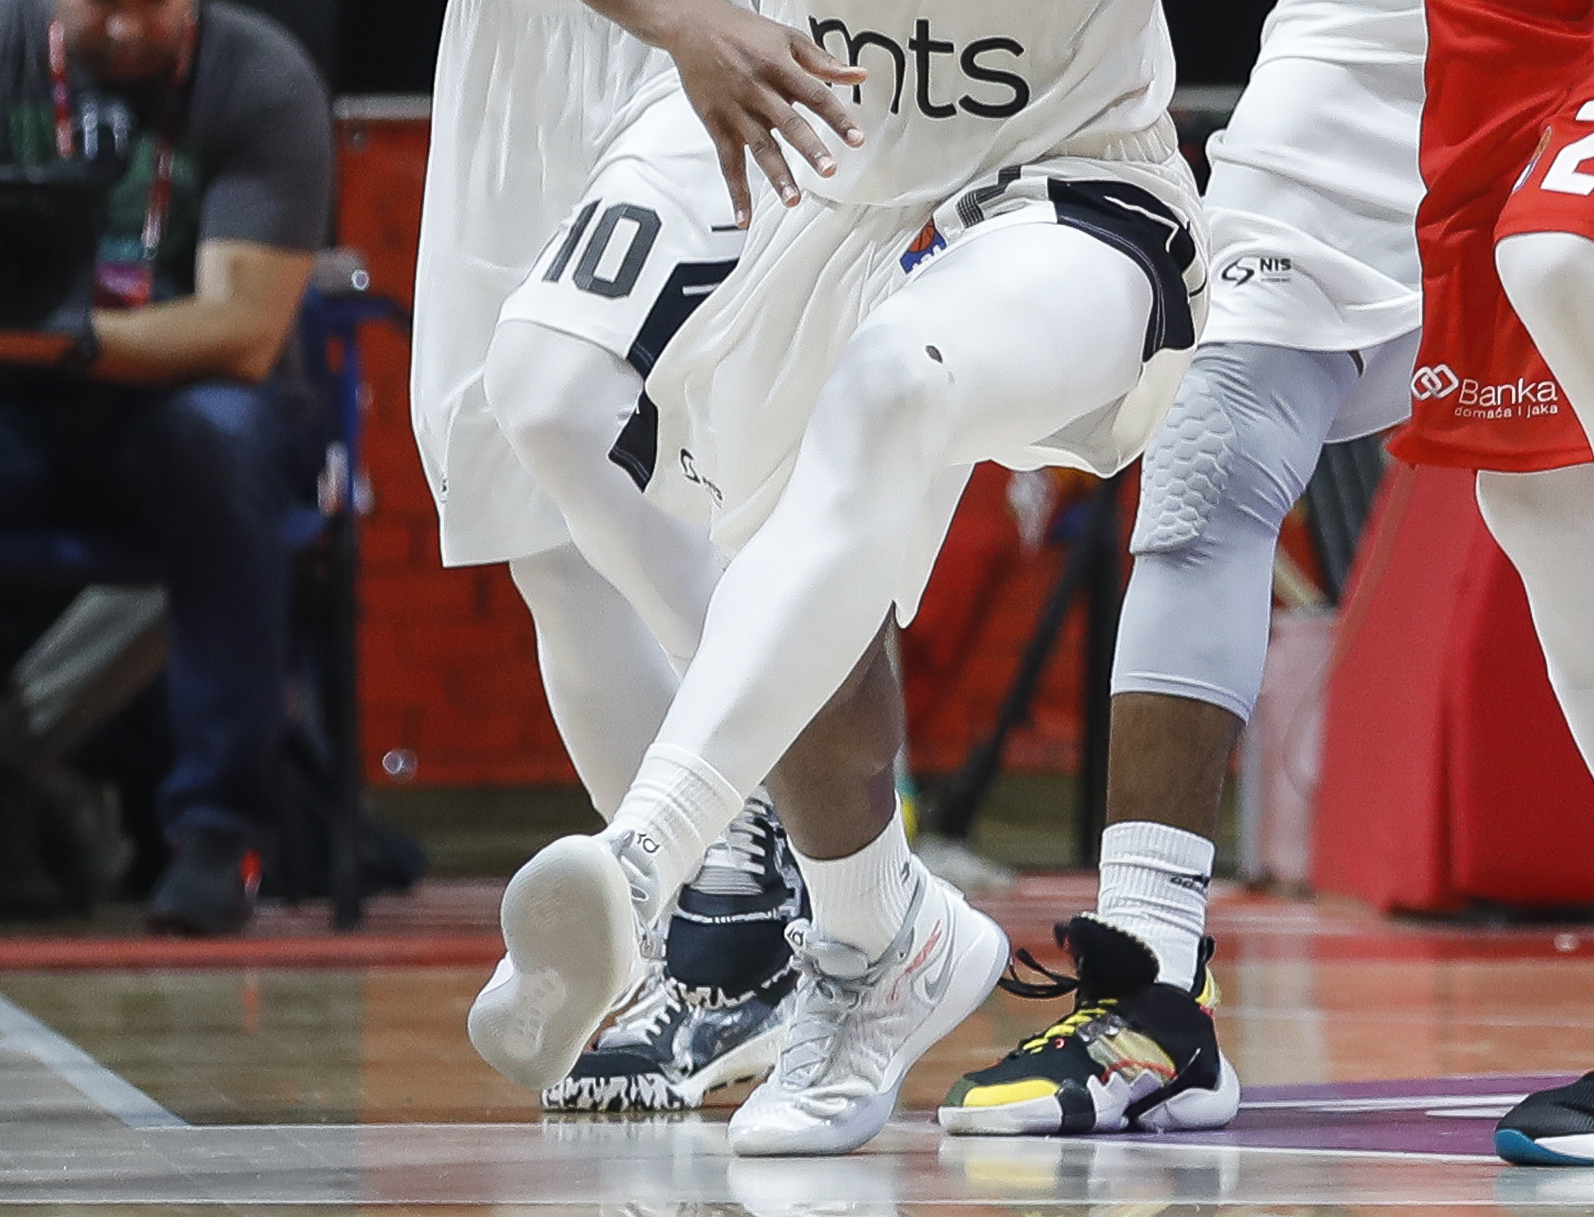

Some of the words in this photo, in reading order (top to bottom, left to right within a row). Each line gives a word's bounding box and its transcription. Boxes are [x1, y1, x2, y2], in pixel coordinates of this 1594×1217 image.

[808, 14, 1031, 120] mts
[541, 196, 663, 300] 10
[1260, 258, 1292, 272] NIS
[1458, 377, 1559, 407] Banka
[1527, 403, 1558, 419] jaka
